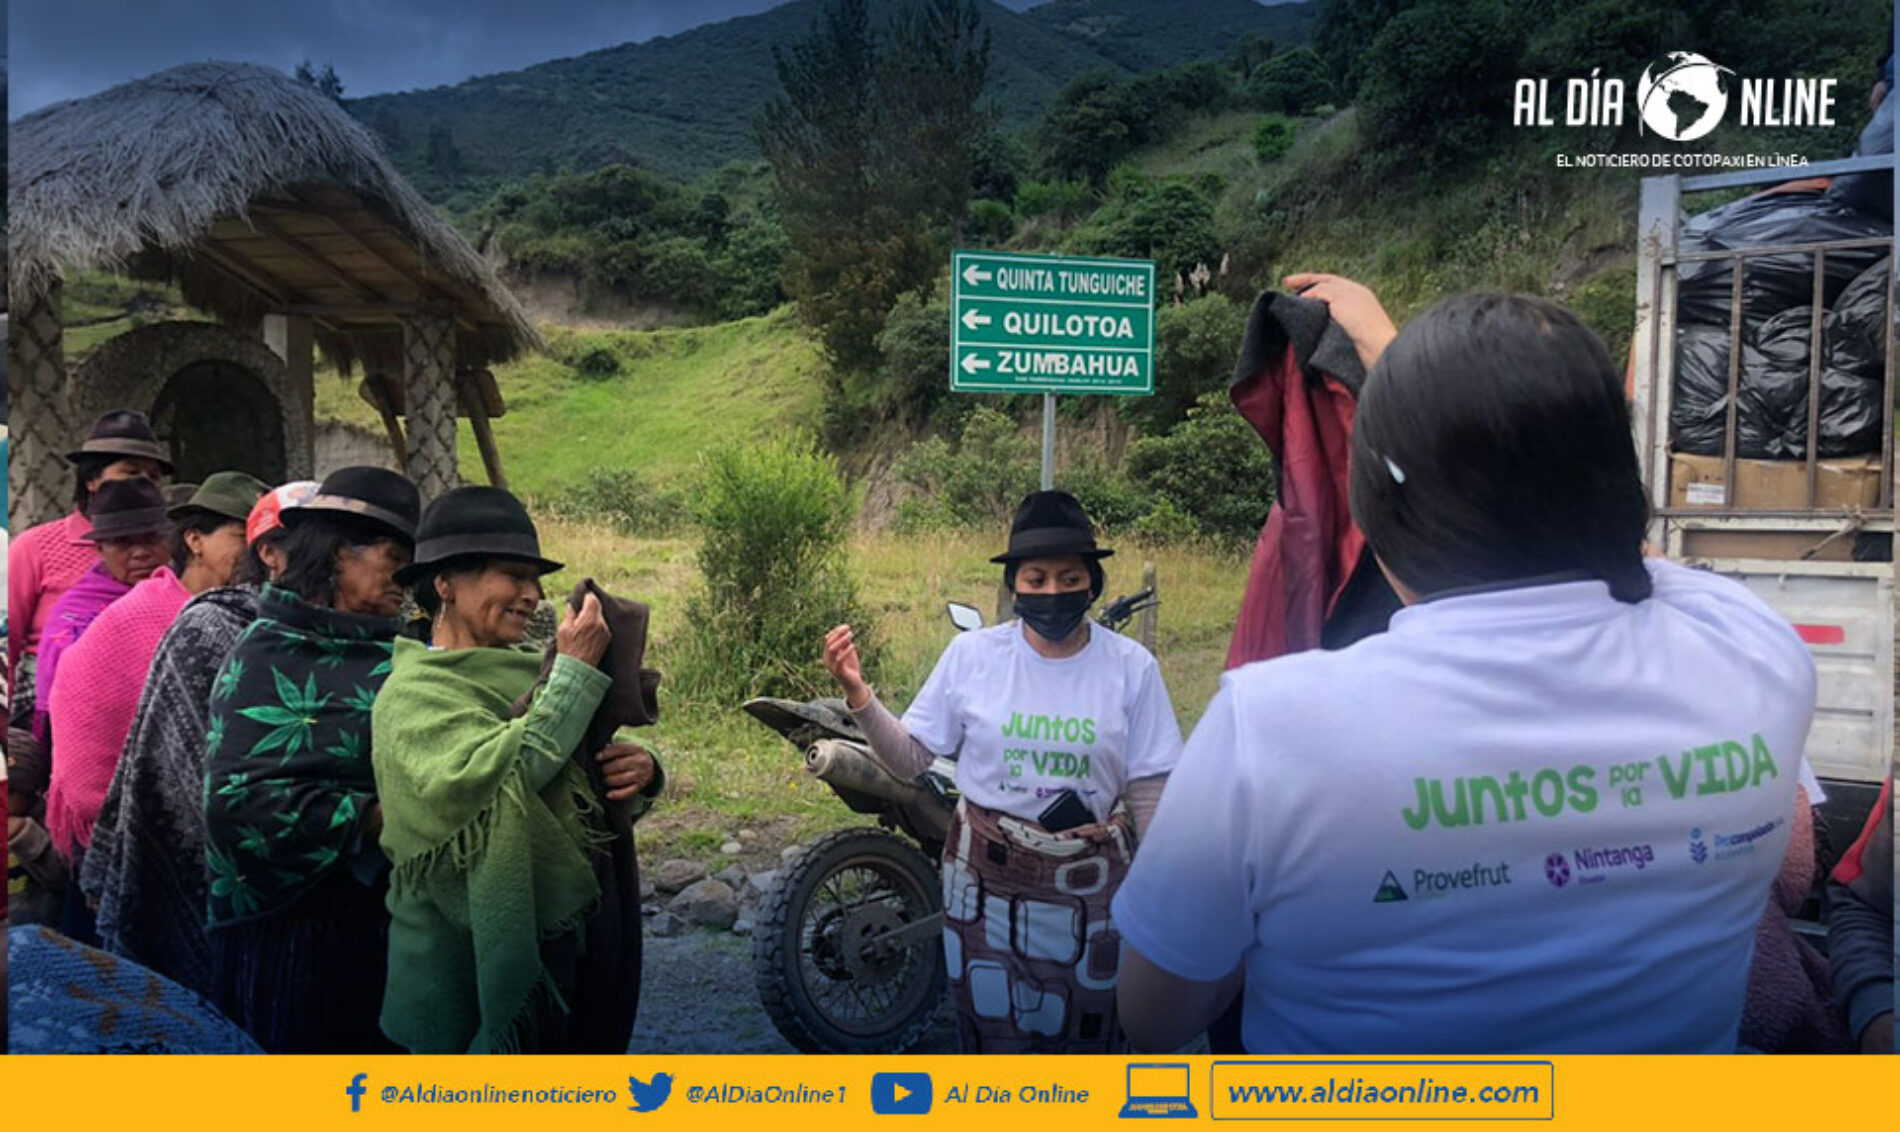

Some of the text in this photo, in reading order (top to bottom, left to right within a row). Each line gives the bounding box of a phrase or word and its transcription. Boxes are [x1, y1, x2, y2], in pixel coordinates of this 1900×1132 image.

[997, 267, 1145, 297] QUINTA TUNGUICHE
[1003, 312, 1134, 338] QUILOTOA
[997, 351, 1139, 377] ZUMBAHUA
[1003, 748, 1028, 762] por
[1031, 750, 1091, 779] VIDA
[1657, 733, 1778, 799] VIDA
[1011, 764, 1022, 777] la
[1609, 760, 1650, 788] por
[1622, 787, 1642, 808] la
[1574, 844, 1655, 870] Nintanga
[1413, 861, 1512, 892] Provefrut
